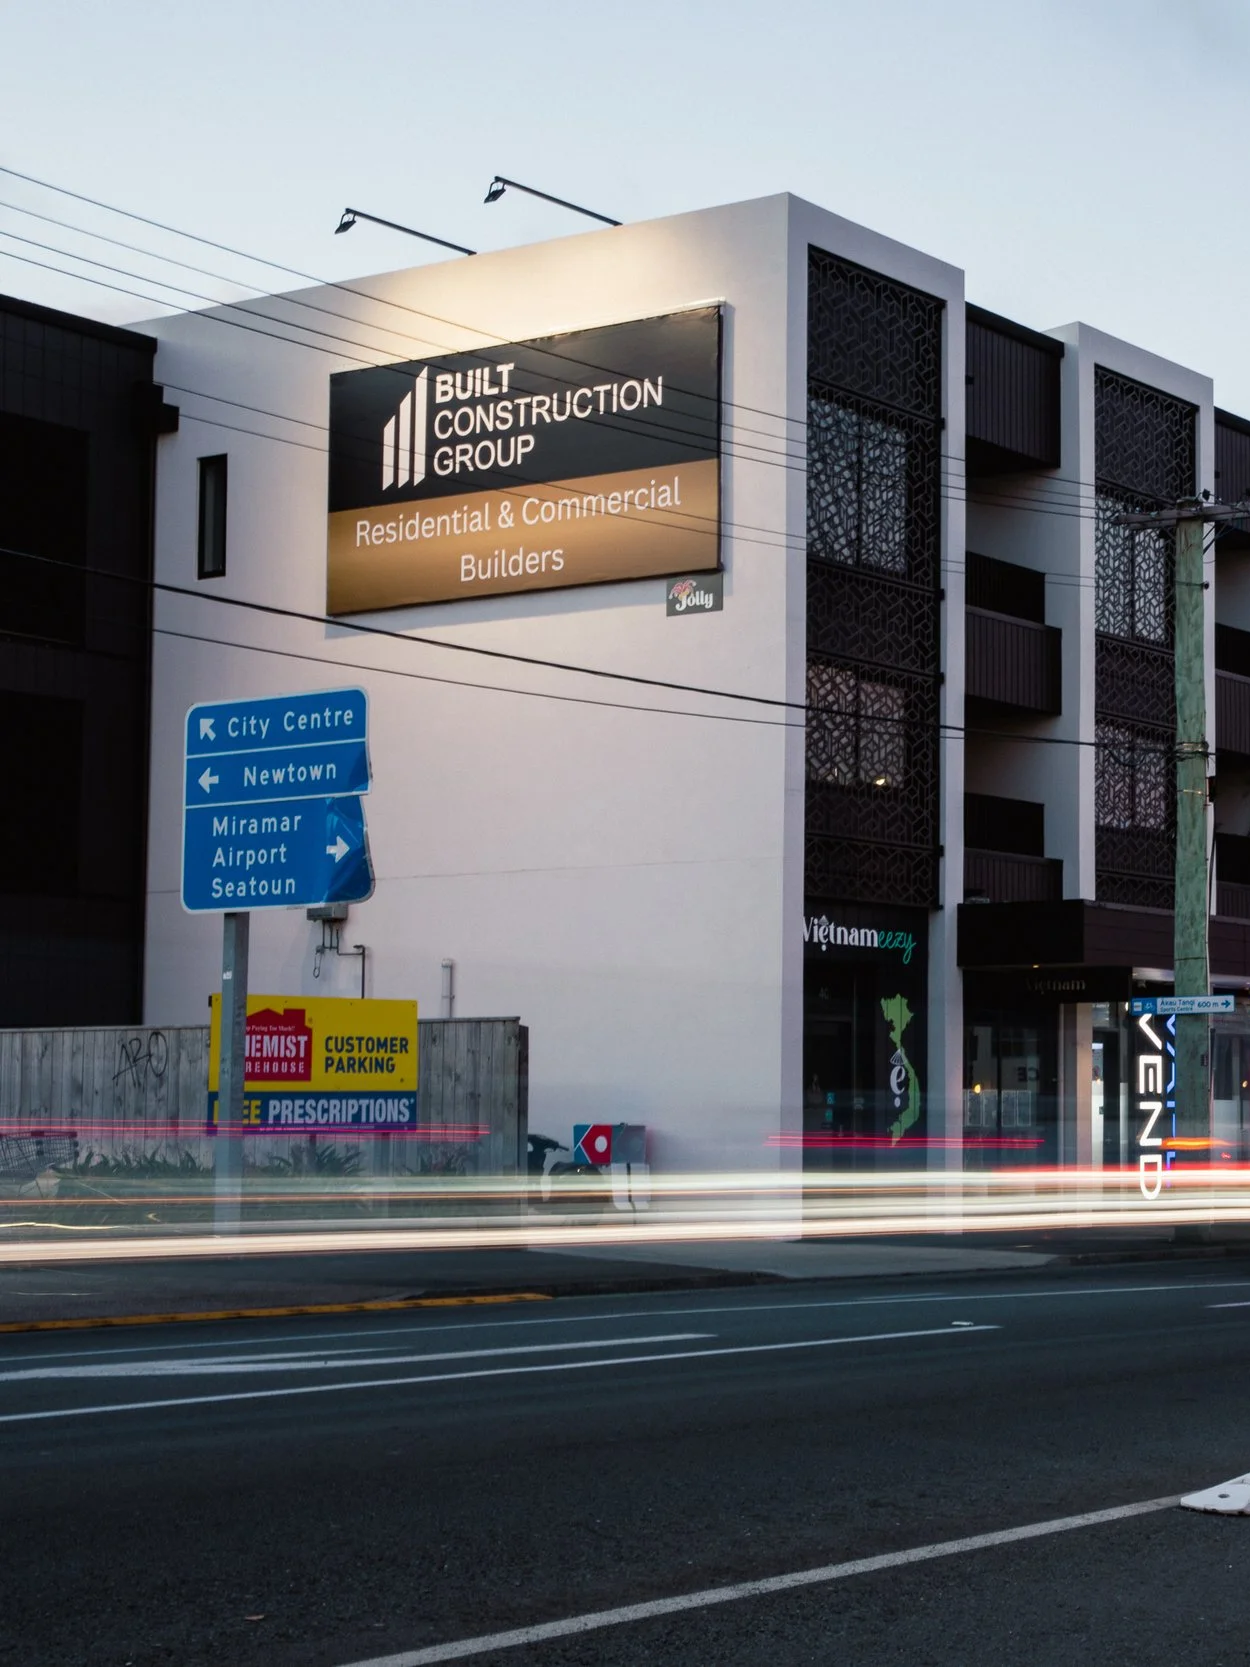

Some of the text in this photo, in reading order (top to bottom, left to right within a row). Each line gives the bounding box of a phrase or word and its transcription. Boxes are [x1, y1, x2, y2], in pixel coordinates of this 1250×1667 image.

[435, 363, 515, 404] BUILT
[433, 376, 663, 440] CONSTRUCTION
[433, 434, 535, 477] GROUP
[356, 476, 681, 547] Residential & Commercial
[460, 548, 564, 582] Builders
[675, 590, 713, 611] Jolly
[228, 708, 353, 739] City Centre
[244, 763, 337, 787] Newtown
[212, 815, 301, 837] Miramar
[212, 843, 287, 870] Airport
[212, 877, 296, 898] Seatoun
[245, 1035, 308, 1058] EMIST
[324, 1036, 409, 1054] CUSTOMER
[245, 1061, 305, 1073] REHOUSE
[324, 1056, 396, 1074] PARKING
[1138, 1014, 1163, 1200] VEND
